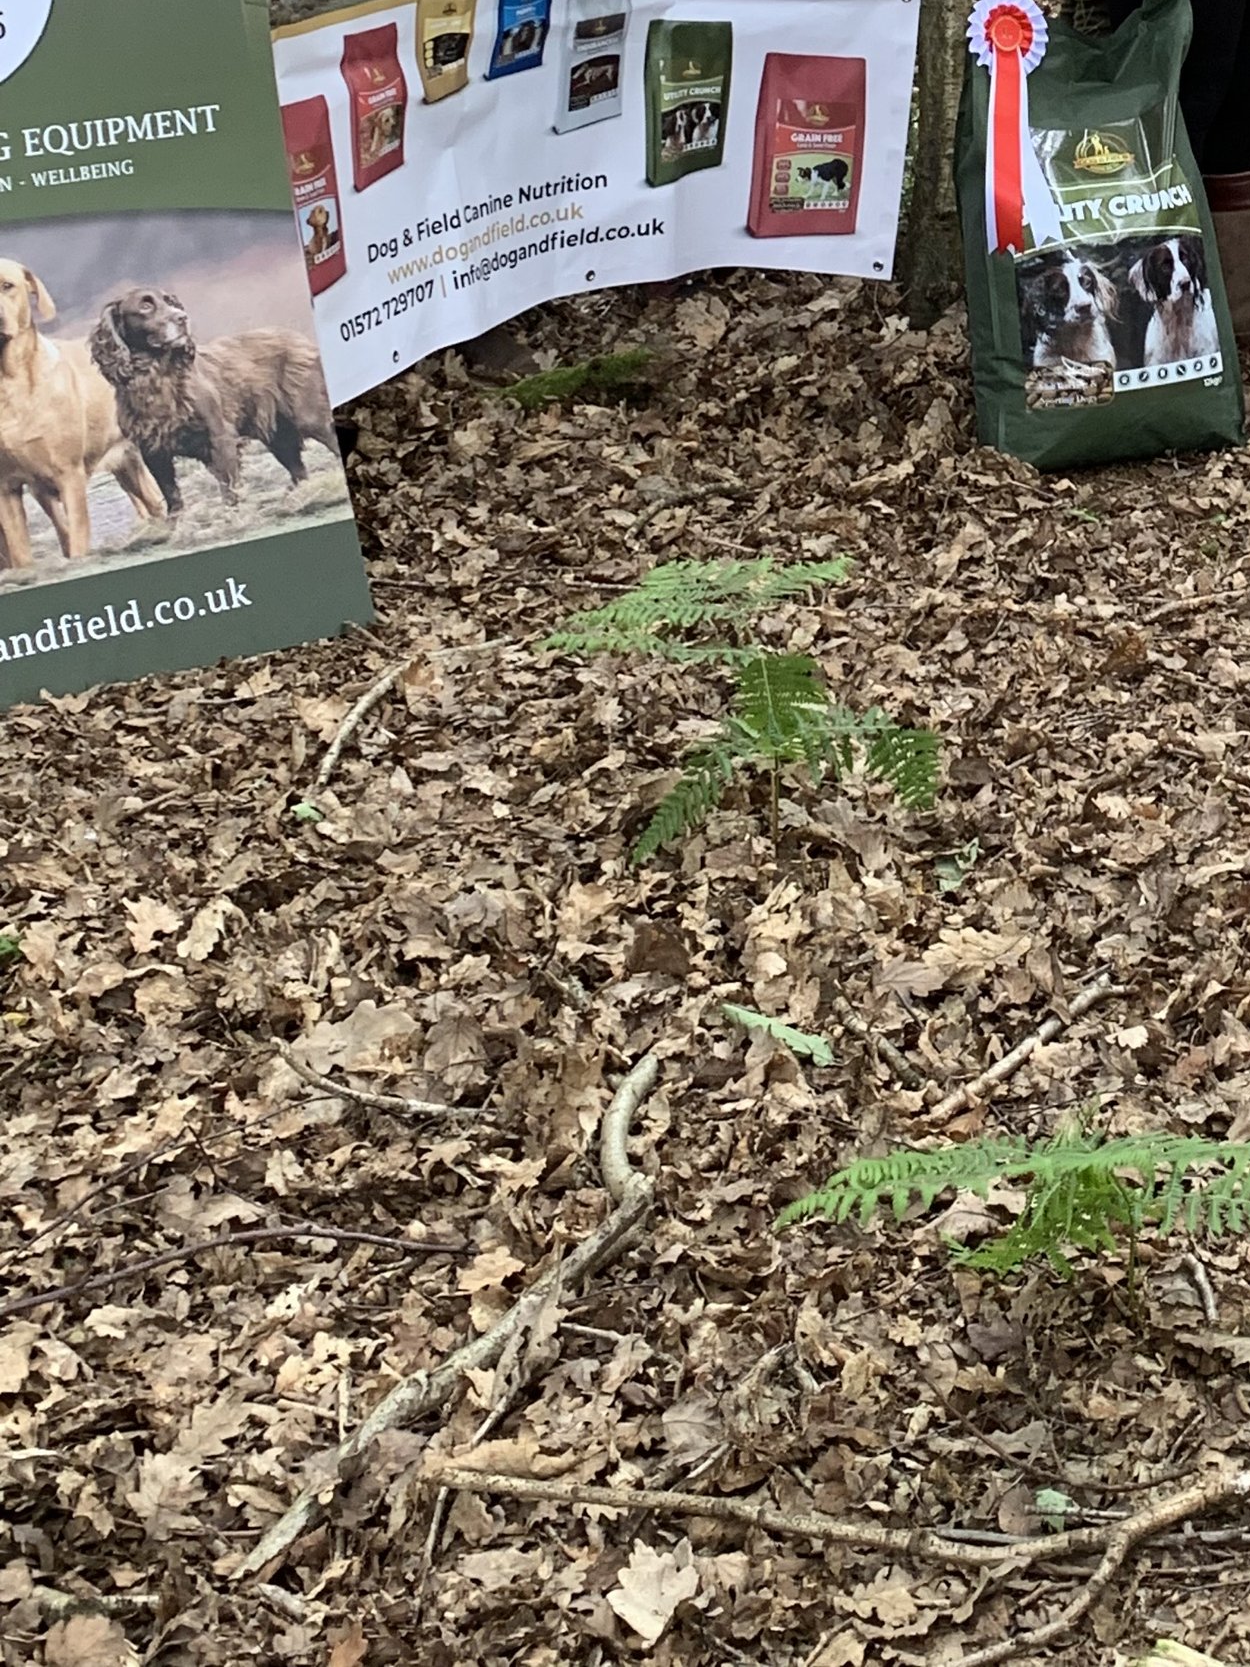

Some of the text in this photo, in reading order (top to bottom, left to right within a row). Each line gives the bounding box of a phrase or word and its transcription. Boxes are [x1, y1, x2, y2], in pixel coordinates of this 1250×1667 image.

[22, 104, 220, 157] EQUIPMENT
[790, 132, 843, 143] GRAIN FREE
[31, 159, 134, 187] WELLBEING
[367, 172, 608, 263] Dog & Field Canine Nutrition
[1108, 184, 1193, 217] CRUNCH
[387, 202, 584, 285] www.dogandfield.co.uk
[340, 307, 383, 342] 01572
[382, 279, 435, 317] 729707
[452, 218, 665, 291] info@dogandfield.co.uk
